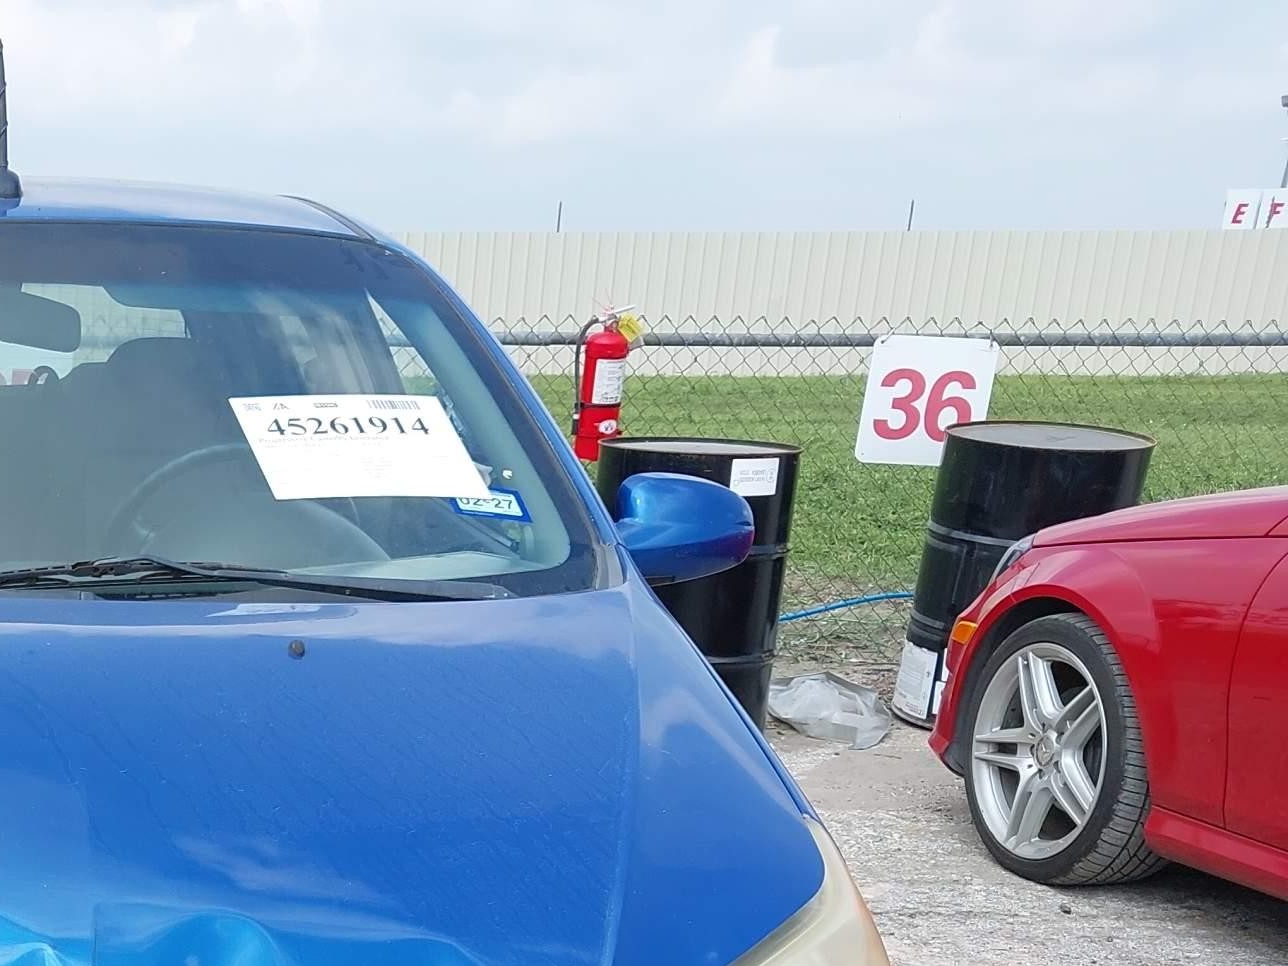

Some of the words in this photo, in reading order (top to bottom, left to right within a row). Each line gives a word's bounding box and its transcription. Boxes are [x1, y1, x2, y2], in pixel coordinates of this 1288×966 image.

[1231, 203, 1249, 224] E
[1267, 202, 1285, 224] F
[873, 368, 976, 443] 36
[267, 416, 429, 436] 45261914
